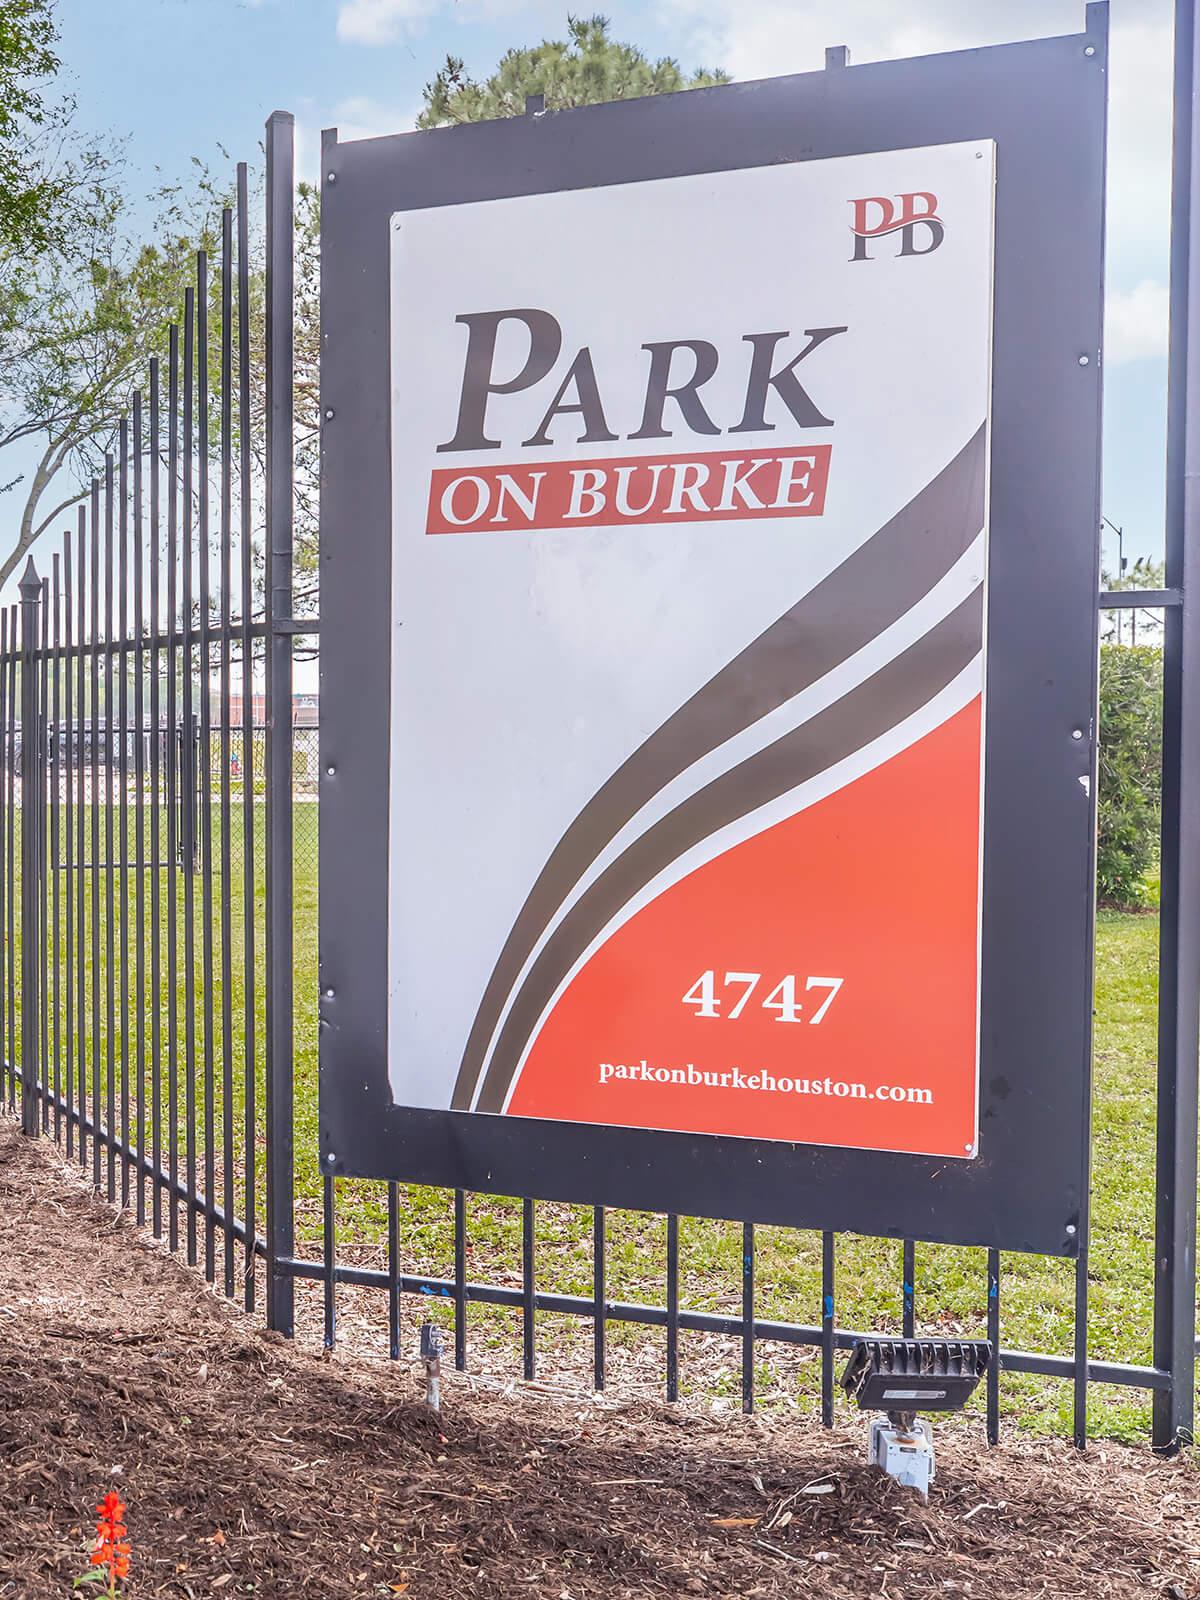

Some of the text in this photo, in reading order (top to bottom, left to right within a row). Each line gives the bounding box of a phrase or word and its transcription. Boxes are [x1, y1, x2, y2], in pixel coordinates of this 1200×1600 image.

[847, 191, 945, 262] PB
[440, 456, 816, 526] ON BURKE
[681, 970, 844, 1025] 4747
[598, 1060, 934, 1104] parkonburkehouston.com
